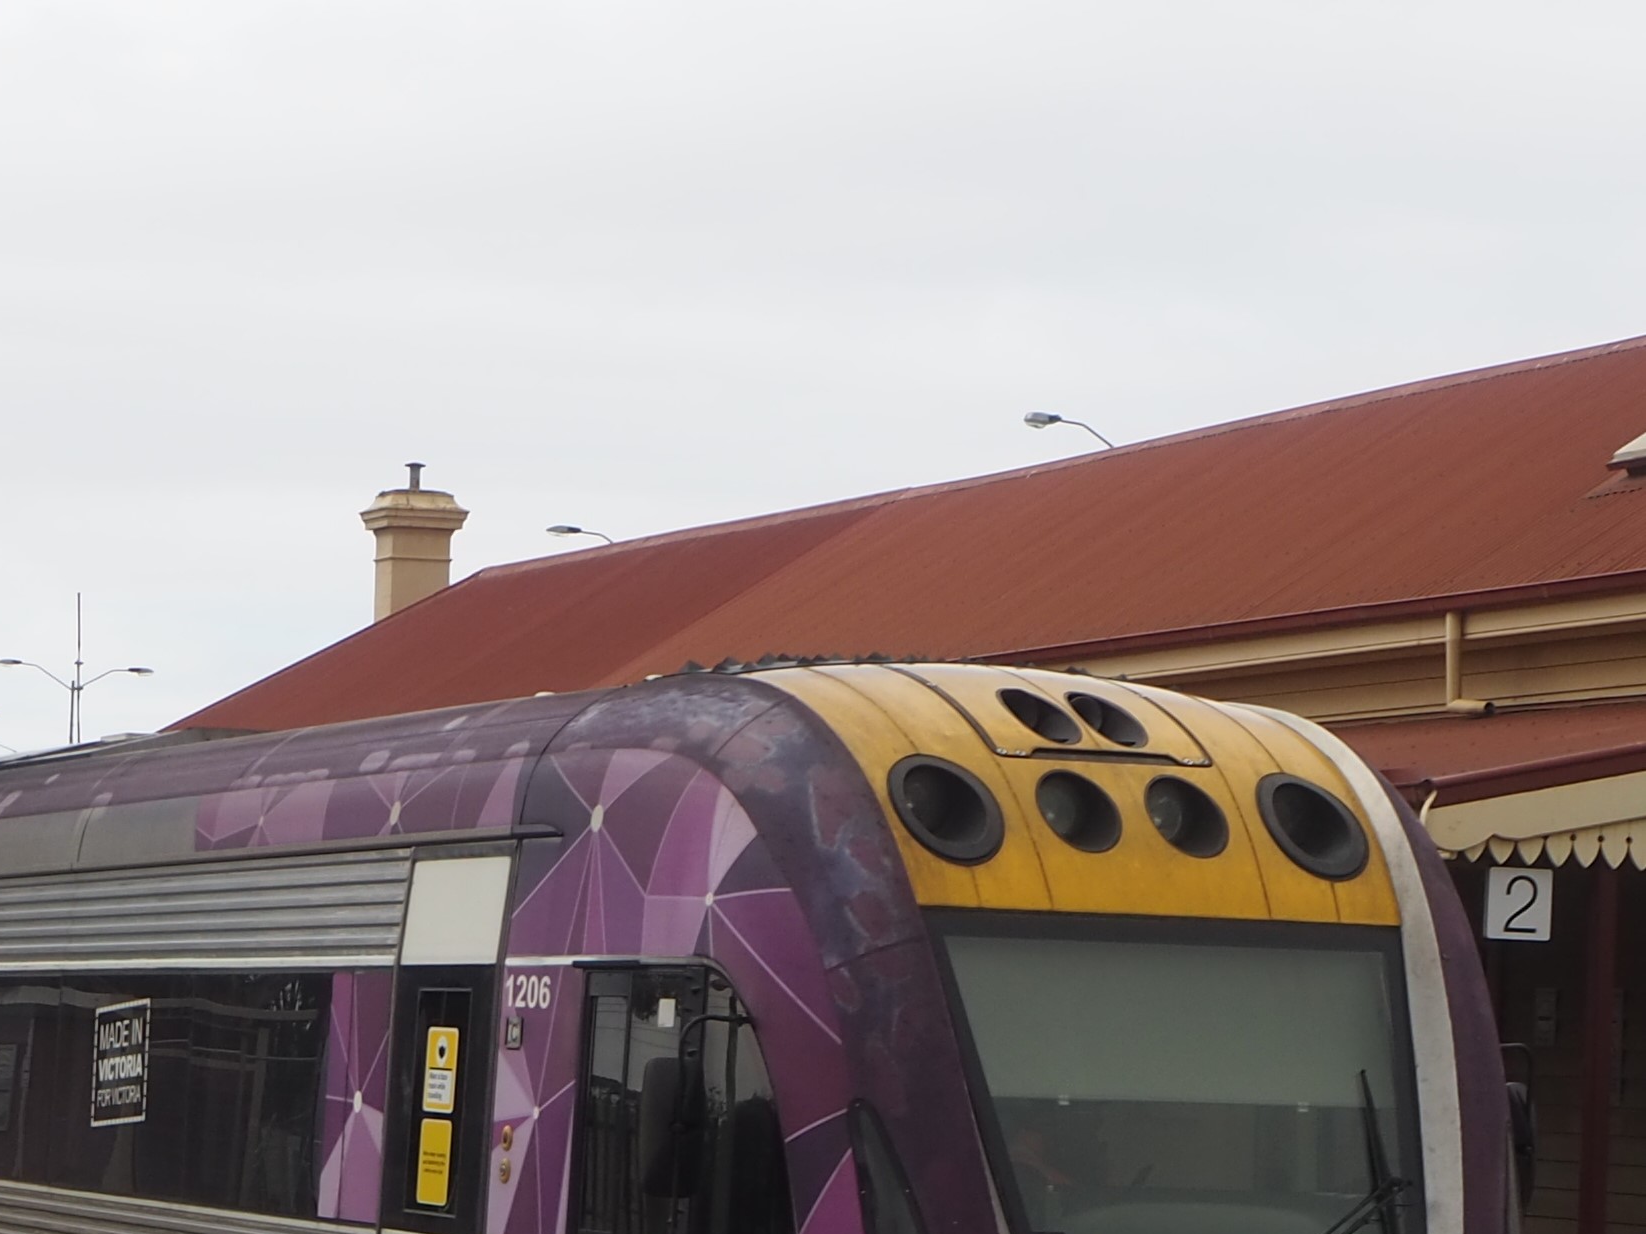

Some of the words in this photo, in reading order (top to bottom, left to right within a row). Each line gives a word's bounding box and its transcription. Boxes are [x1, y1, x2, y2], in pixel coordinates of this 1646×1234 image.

[1503, 875, 1538, 934] 2
[506, 974, 552, 1010] 1206
[99, 1019, 130, 1051] MADE
[131, 1017, 143, 1045] IN
[98, 1053, 143, 1082] VICTORIA
[97, 1088, 111, 1107] FOR
[111, 1084, 142, 1105] VICTORIA
